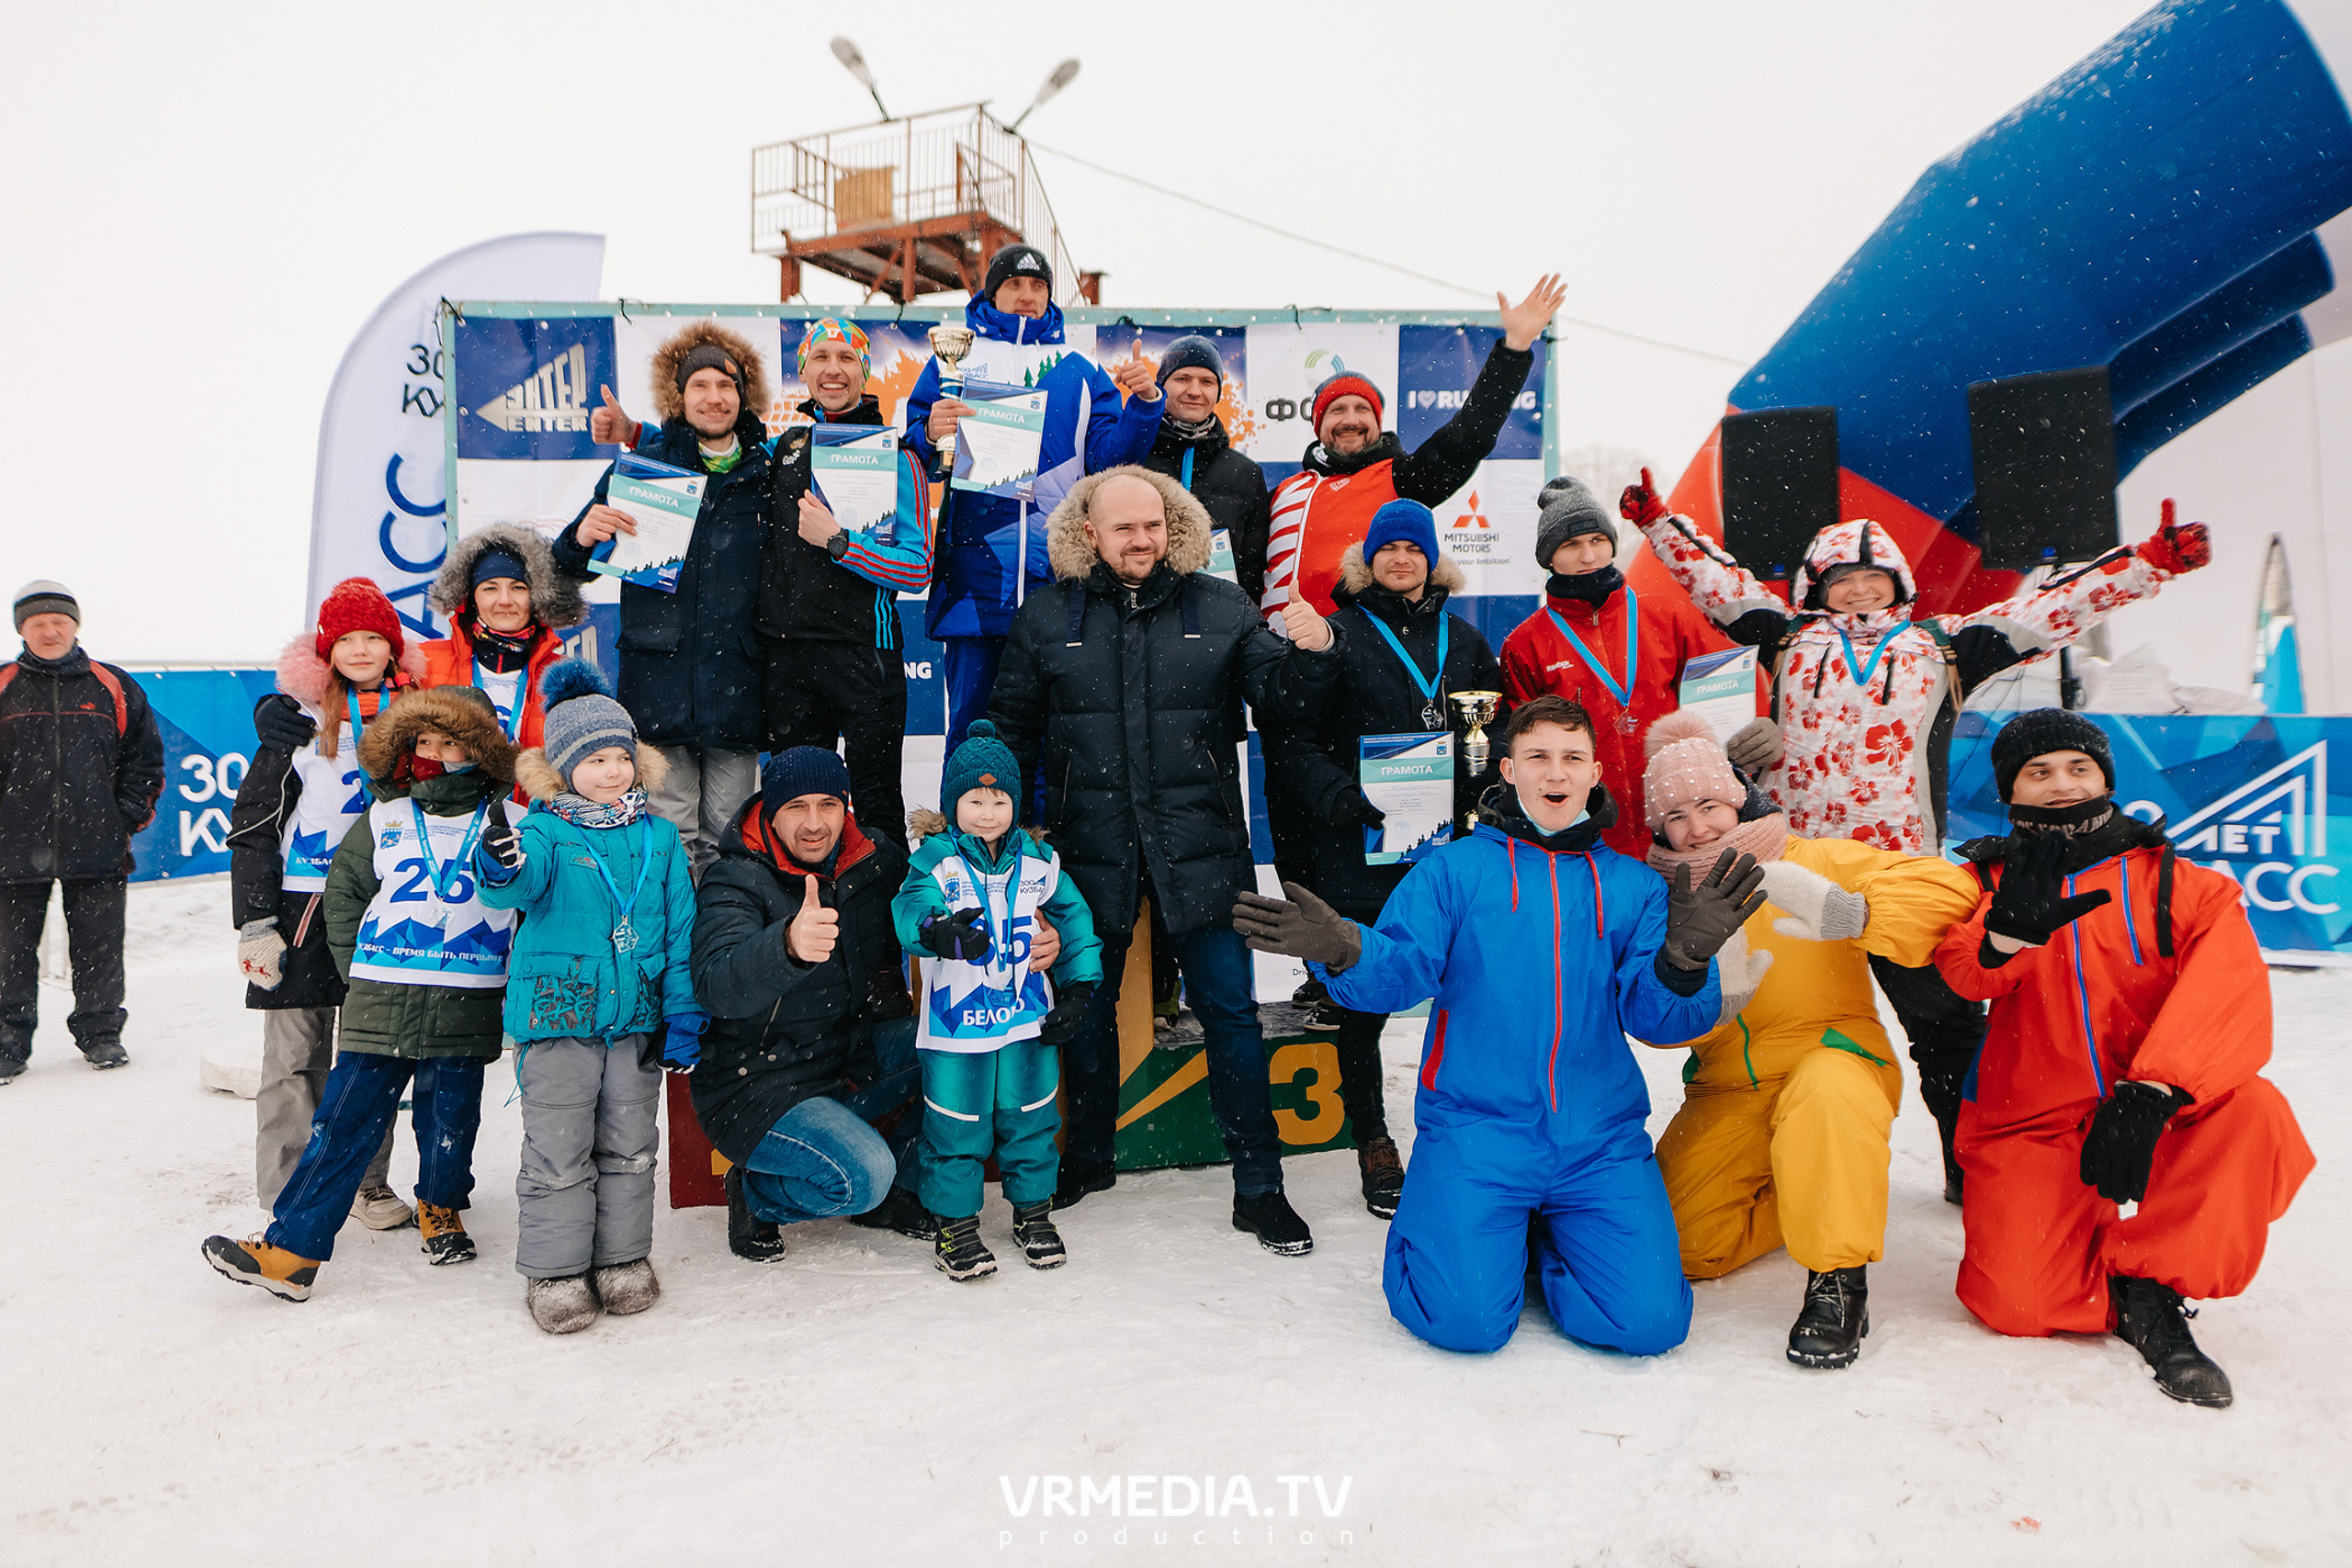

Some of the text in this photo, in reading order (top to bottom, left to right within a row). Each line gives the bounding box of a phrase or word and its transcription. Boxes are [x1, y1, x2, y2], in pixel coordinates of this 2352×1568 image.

[506, 342, 588, 411] ЭНТЕР
[978, 407, 1025, 423] ГРАМОТА
[506, 416, 589, 433] ENTER
[831, 454, 879, 465] ГРАМОТА
[629, 485, 680, 508] ГРАМОТА
[1444, 533, 1499, 543] MITSUBISHI
[1453, 544, 1491, 553] MOTORS
[1696, 679, 1739, 695] ГРАМОТА
[1381, 764, 1433, 776] ГРАМОТА
[392, 947, 425, 957] ВРЕМЯ
[427, 949, 457, 960] БЫТЬ
[1269, 1042, 1345, 1145] 3
